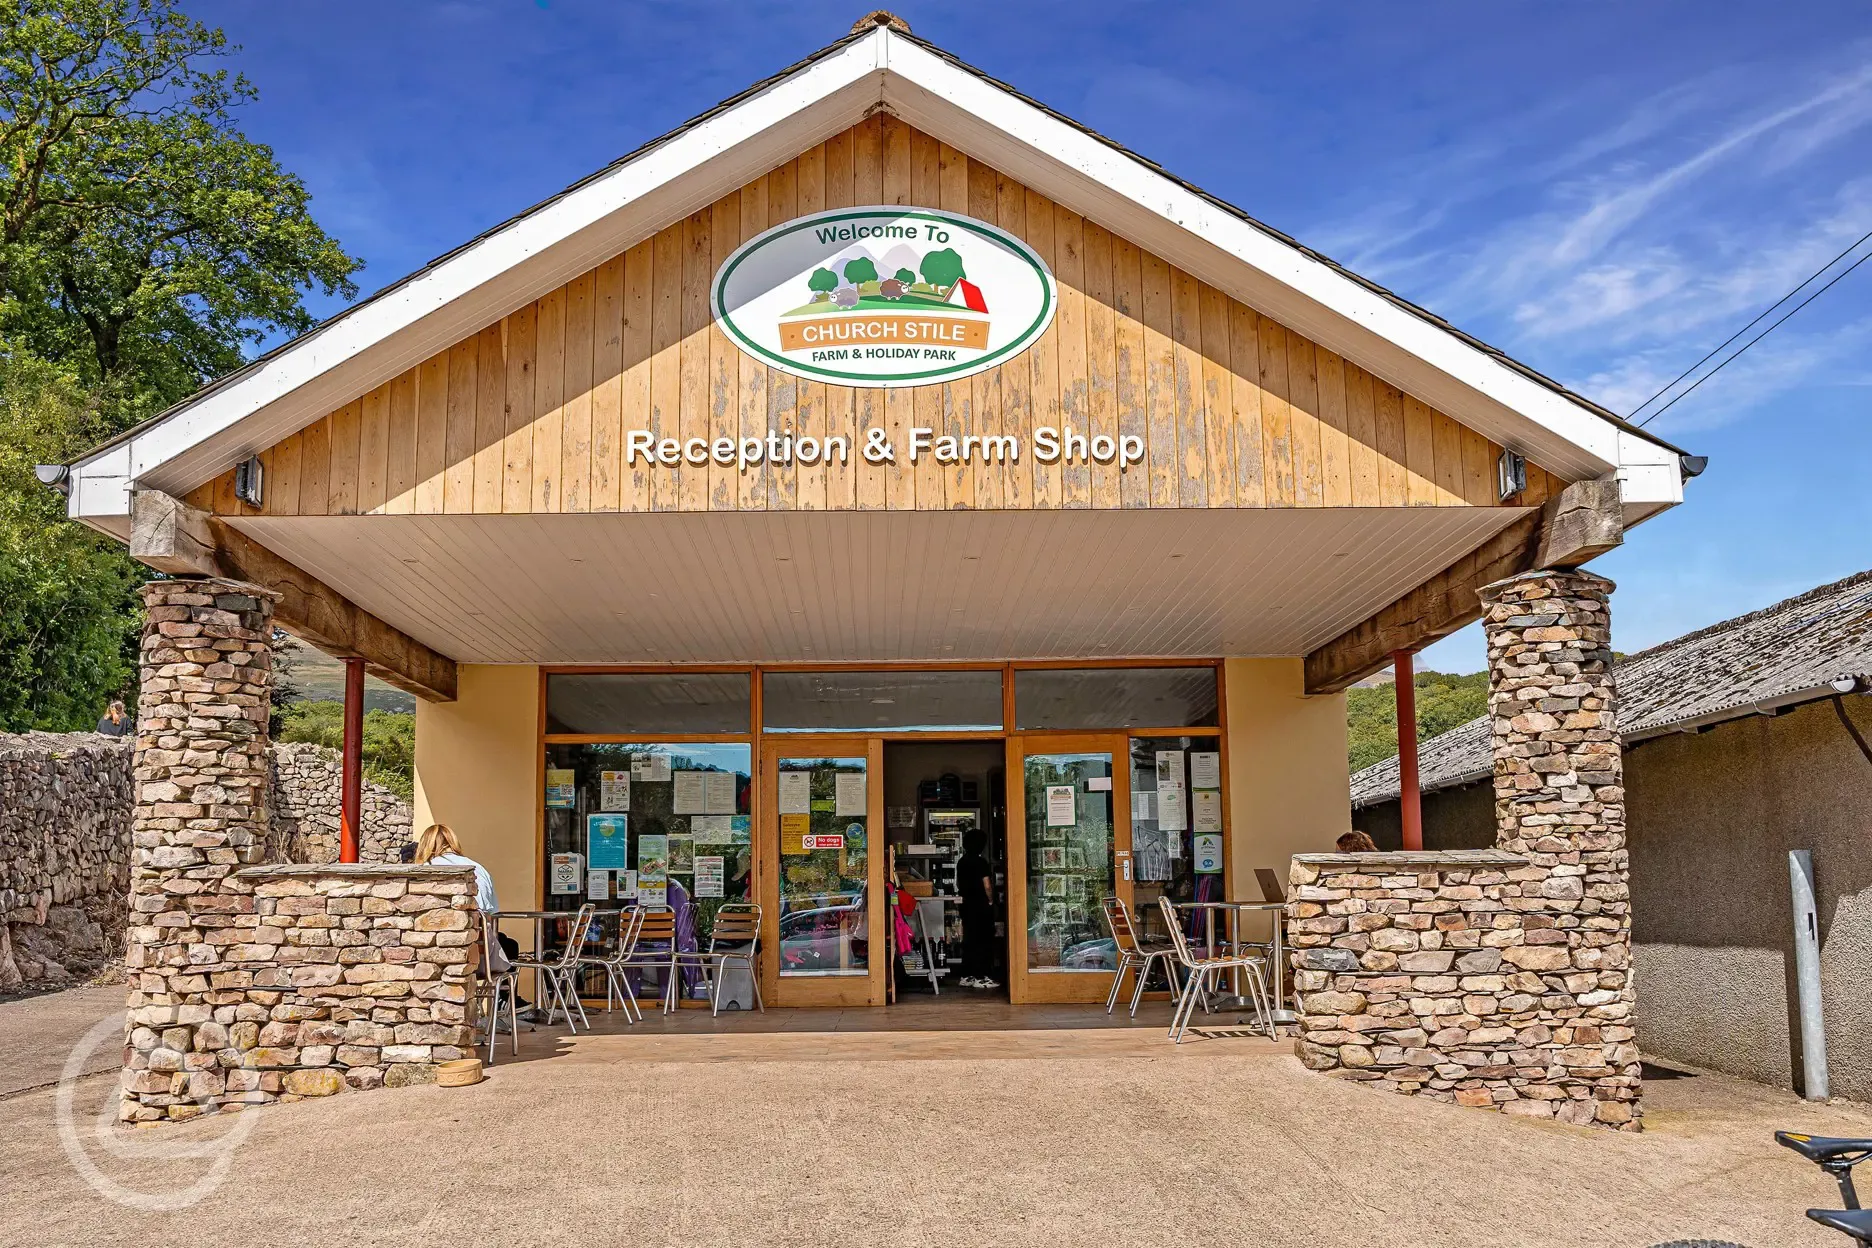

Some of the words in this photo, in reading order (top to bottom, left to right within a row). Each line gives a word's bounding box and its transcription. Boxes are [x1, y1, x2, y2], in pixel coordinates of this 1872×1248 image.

[815, 223, 918, 245] Welcome
[924, 224, 950, 244] To
[802, 321, 897, 342] CHURCH
[904, 321, 966, 341] STILE
[812, 349, 848, 362] FARM
[852, 348, 862, 359] &
[866, 348, 921, 359] HOLIDAY
[924, 349, 956, 361] PARK
[627, 428, 848, 470] Reception
[863, 428, 896, 462] &
[910, 428, 1018, 461] Farm
[1034, 427, 1144, 468] Shop
